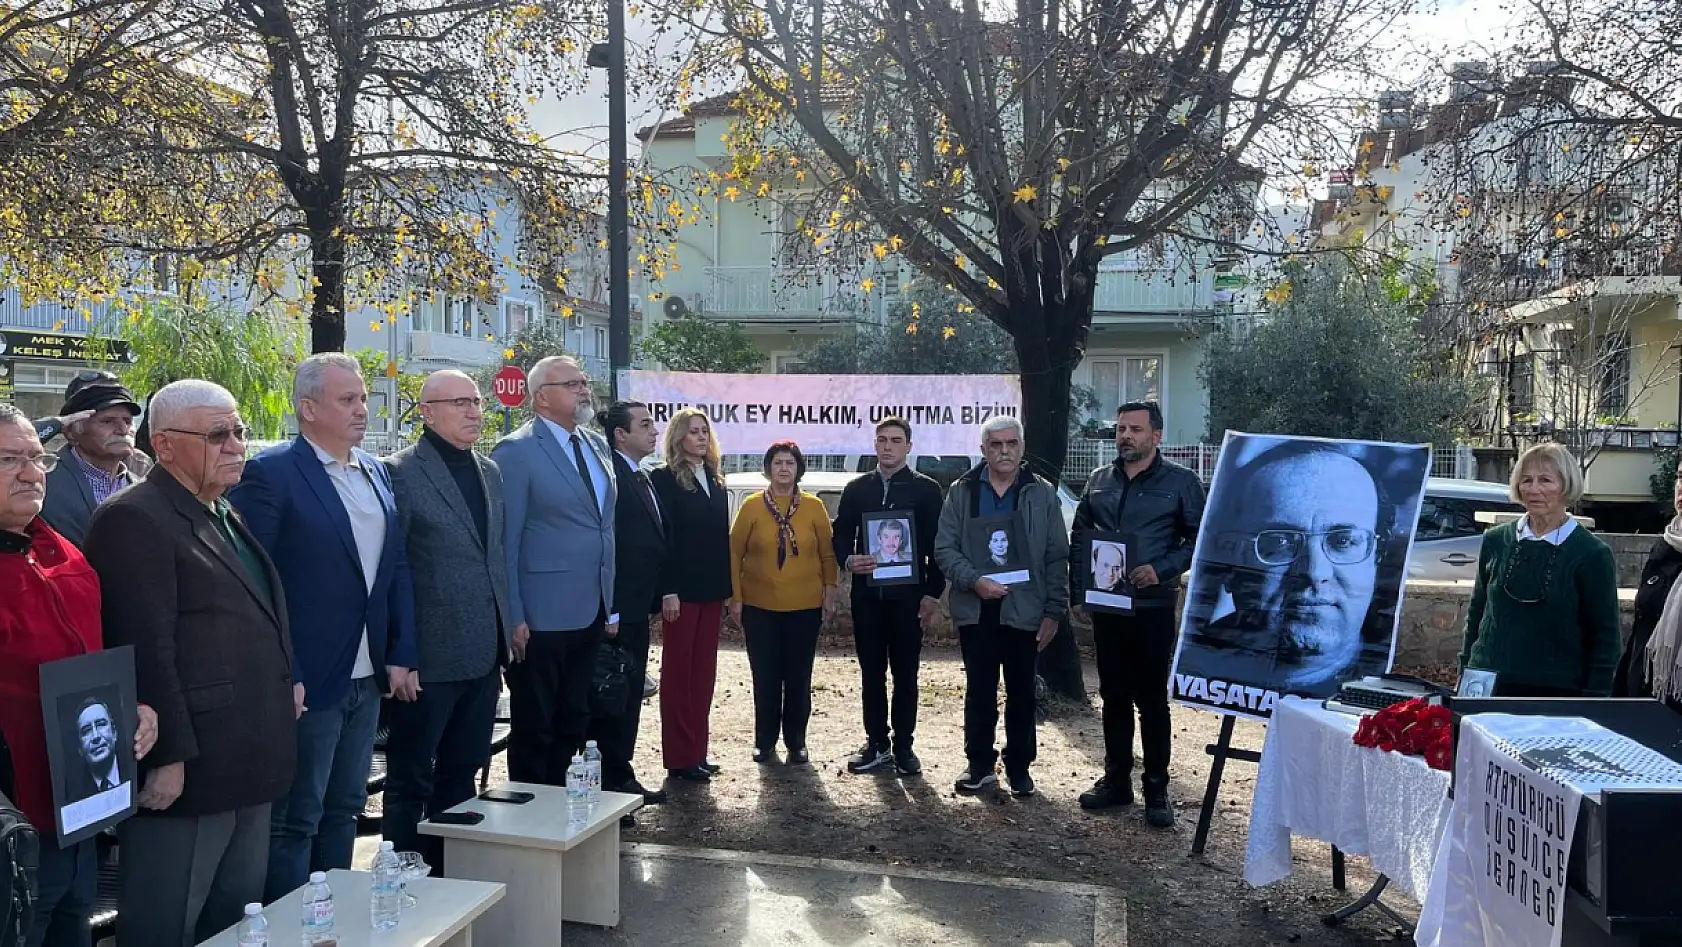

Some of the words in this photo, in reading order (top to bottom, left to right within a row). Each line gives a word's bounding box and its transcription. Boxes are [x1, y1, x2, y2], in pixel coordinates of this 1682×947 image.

[31, 336, 65, 346] MEK
[13, 346, 63, 359] KELEŞ
[496, 377, 526, 396] DUR
[745, 404, 772, 423] EY
[778, 405, 862, 428] HALKIM,
[869, 405, 955, 425] UNUTMA
[1175, 673, 1281, 712] YAŞATA
[1485, 761, 1566, 841] ATATÜRKÇÜ
